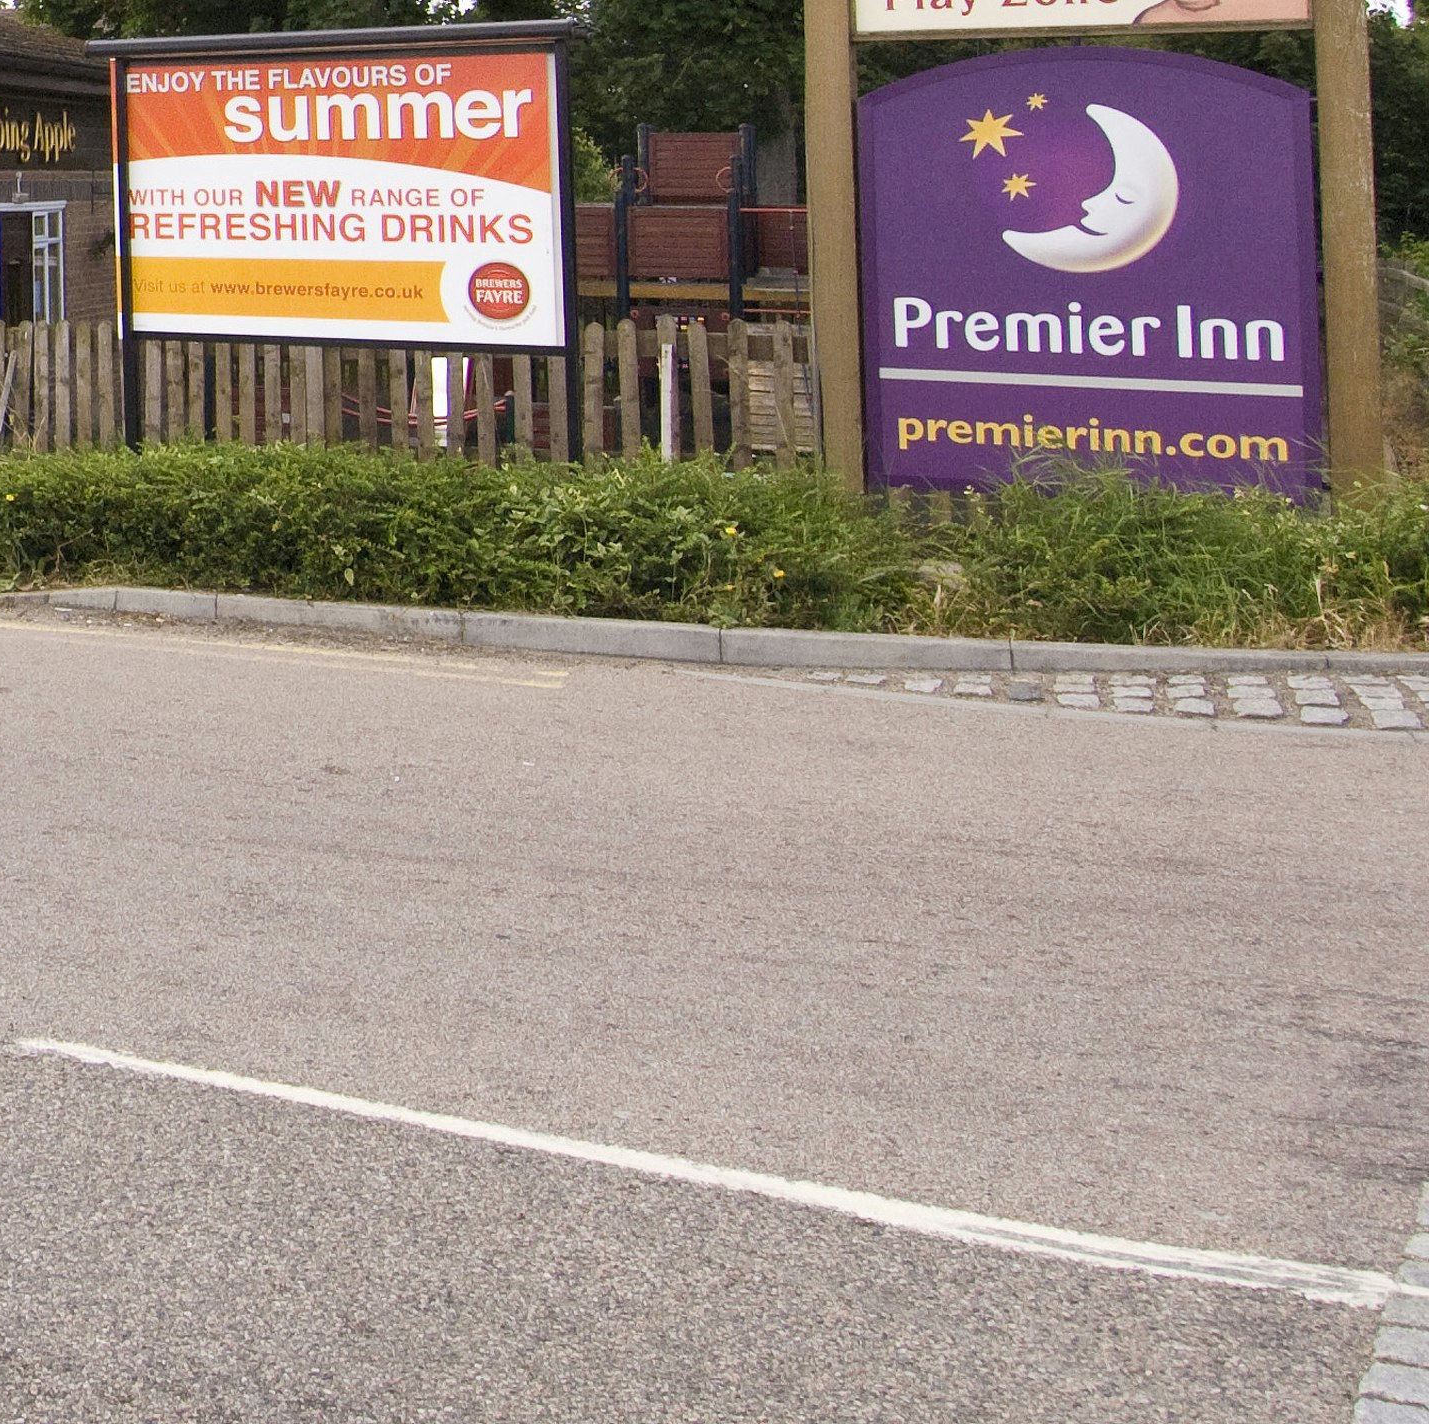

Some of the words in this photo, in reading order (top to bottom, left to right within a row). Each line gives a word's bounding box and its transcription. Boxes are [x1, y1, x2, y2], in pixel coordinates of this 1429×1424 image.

[127, 72, 204, 94] ENJOY
[212, 69, 260, 91] THE
[268, 65, 407, 89] FLAVOURS
[415, 63, 452, 85] OF
[223, 87, 532, 143] summer
[33, 110, 76, 163] Apple
[129, 188, 185, 207] WITH
[194, 189, 242, 207] OUR
[255, 180, 341, 208] NEW
[351, 189, 440, 207] RANGE
[450, 188, 485, 207] OF
[129, 213, 366, 242] REFRESHING
[381, 214, 534, 244] DRINKS
[134, 278, 164, 293] Visit
[169, 282, 186, 293] us
[192, 280, 205, 294] at
[210, 281, 424, 300] www.brewersfayre.co.uk
[476, 278, 522, 288] BREWERS
[476, 290, 523, 304] FAYRE
[893, 296, 1161, 358] Premier
[1177, 305, 1285, 362] Inn
[897, 413, 1289, 462] premierinn.com
